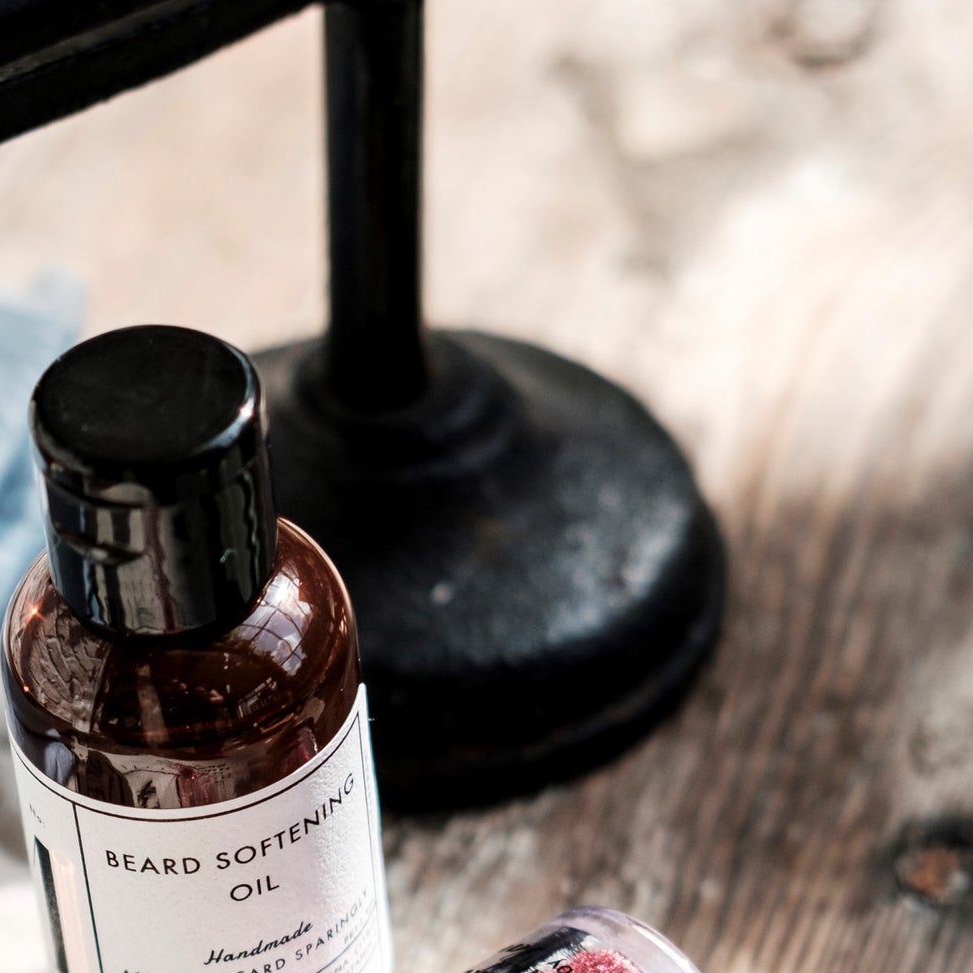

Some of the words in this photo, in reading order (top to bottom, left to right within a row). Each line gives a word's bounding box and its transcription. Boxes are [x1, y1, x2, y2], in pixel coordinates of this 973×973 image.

[105, 849, 201, 875] BEARD
[215, 771, 355, 870] SOFTENING
[229, 875, 280, 902] OIL
[203, 920, 314, 966] Handmade
